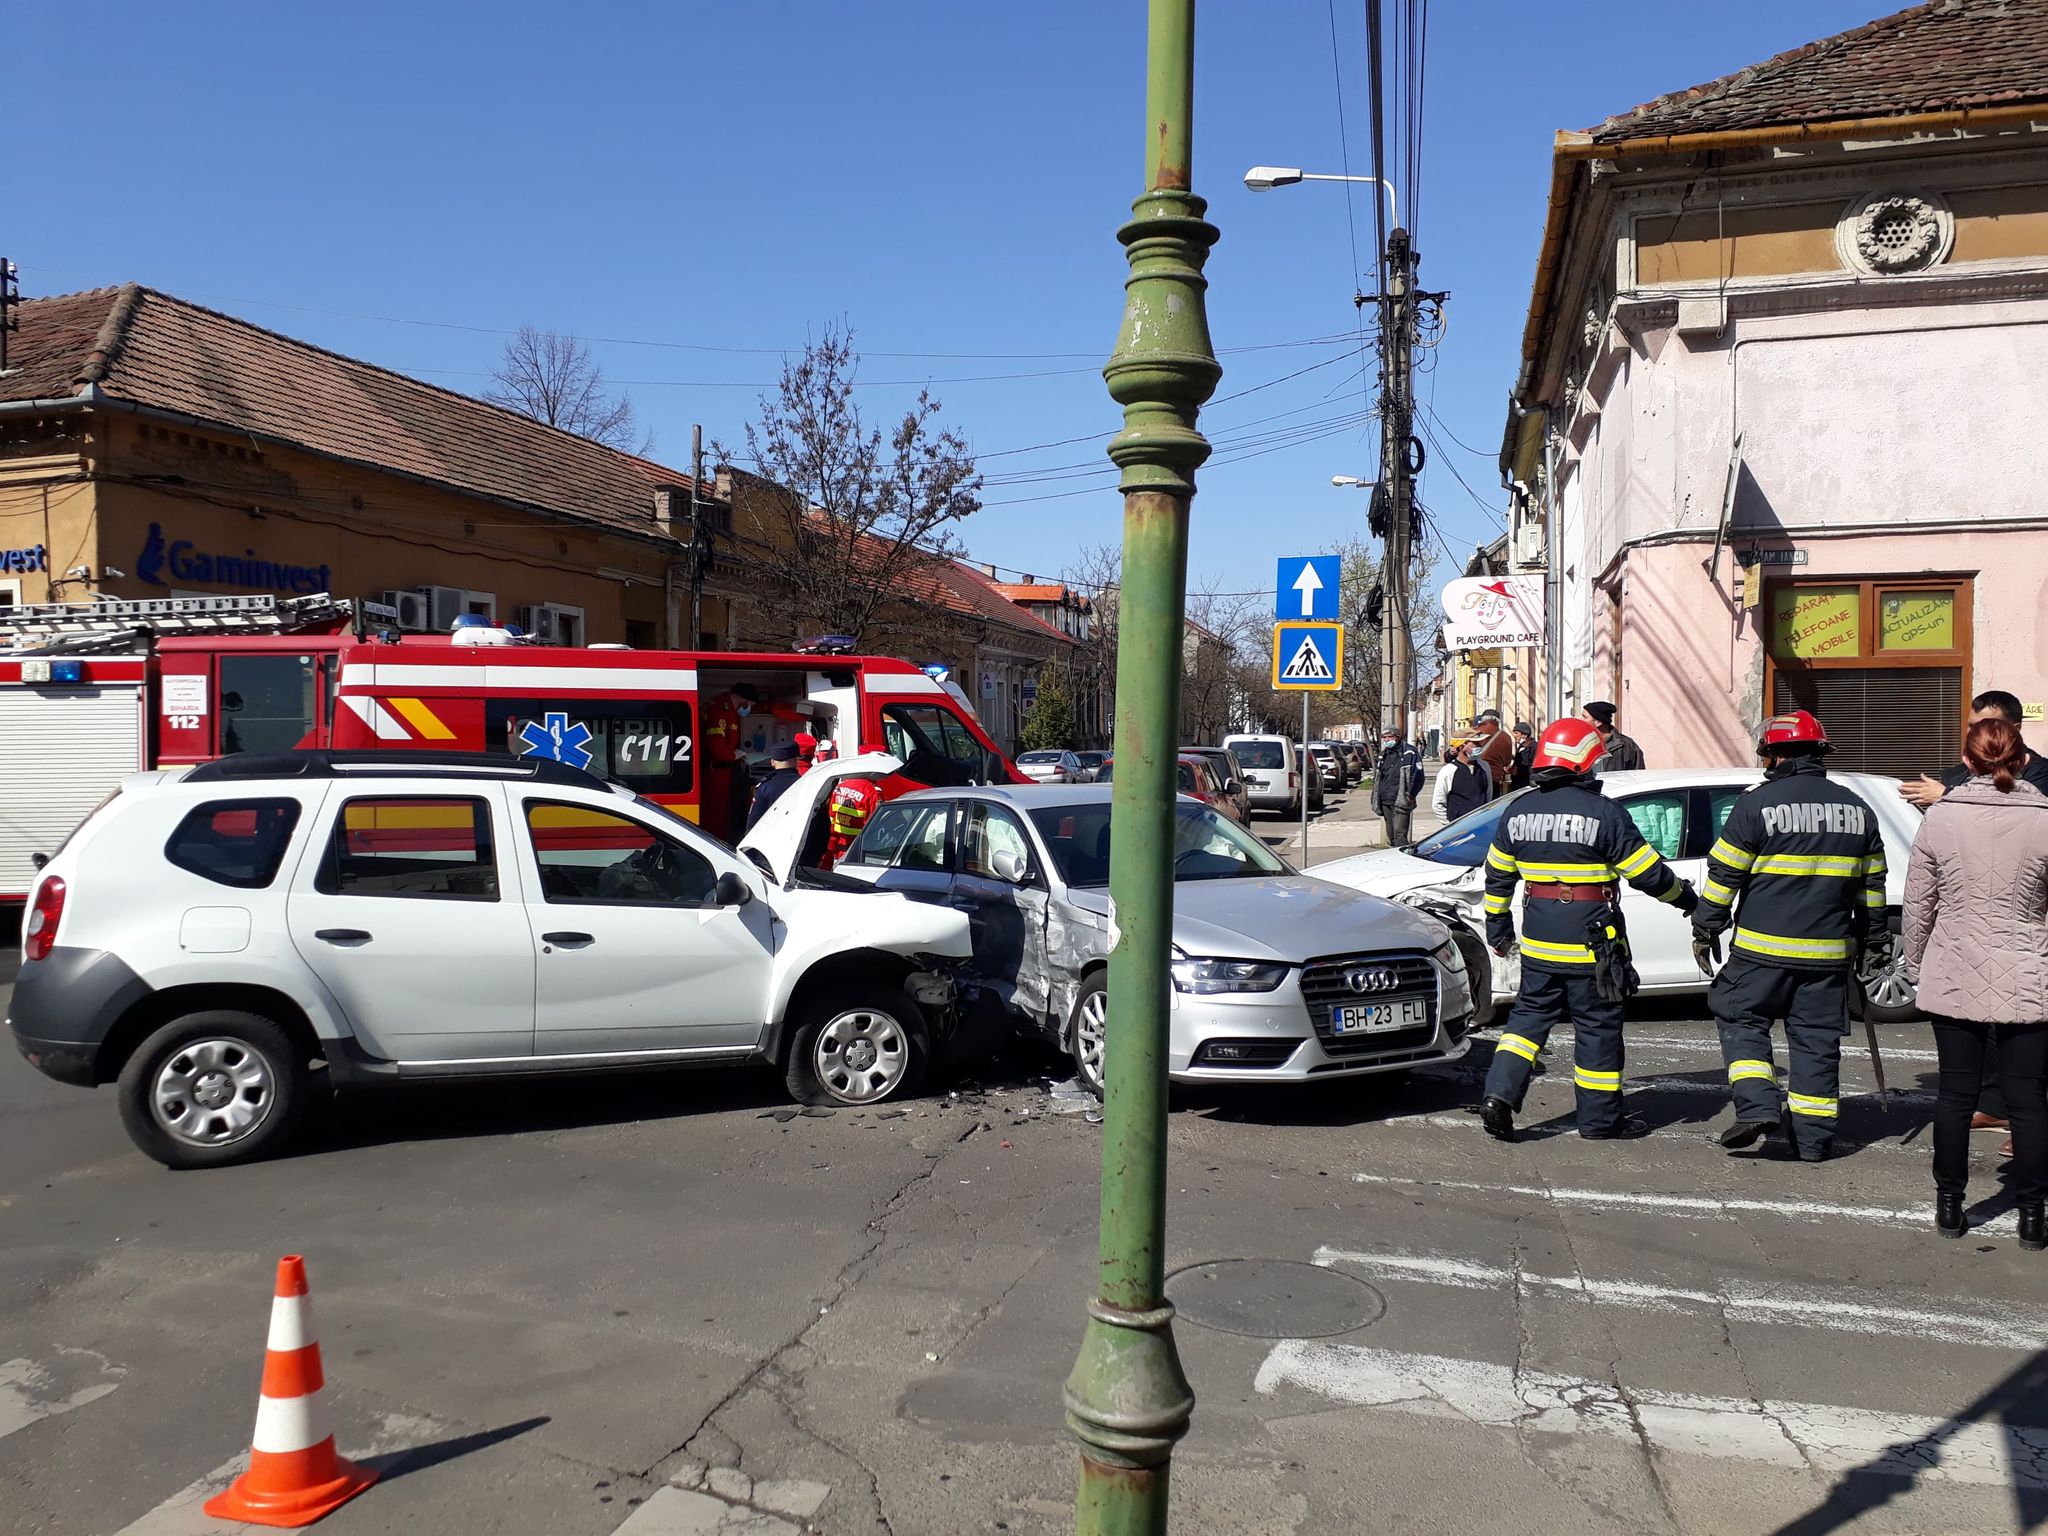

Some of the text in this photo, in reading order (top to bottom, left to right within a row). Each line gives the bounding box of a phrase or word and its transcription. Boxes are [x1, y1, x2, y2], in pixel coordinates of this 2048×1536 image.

[169, 540, 331, 593] Gaminvest
[1456, 632, 1540, 645] PLAYGROUND CAFE
[1783, 609, 1852, 647] TELEFOANE
[1811, 629, 1856, 656] MOBILE
[168, 715, 200, 729] 112
[637, 735, 692, 761] 112
[1507, 813, 1600, 847] POMPIERII
[1344, 1007, 1368, 1029] BH
[1373, 1005, 1393, 1025] 23
